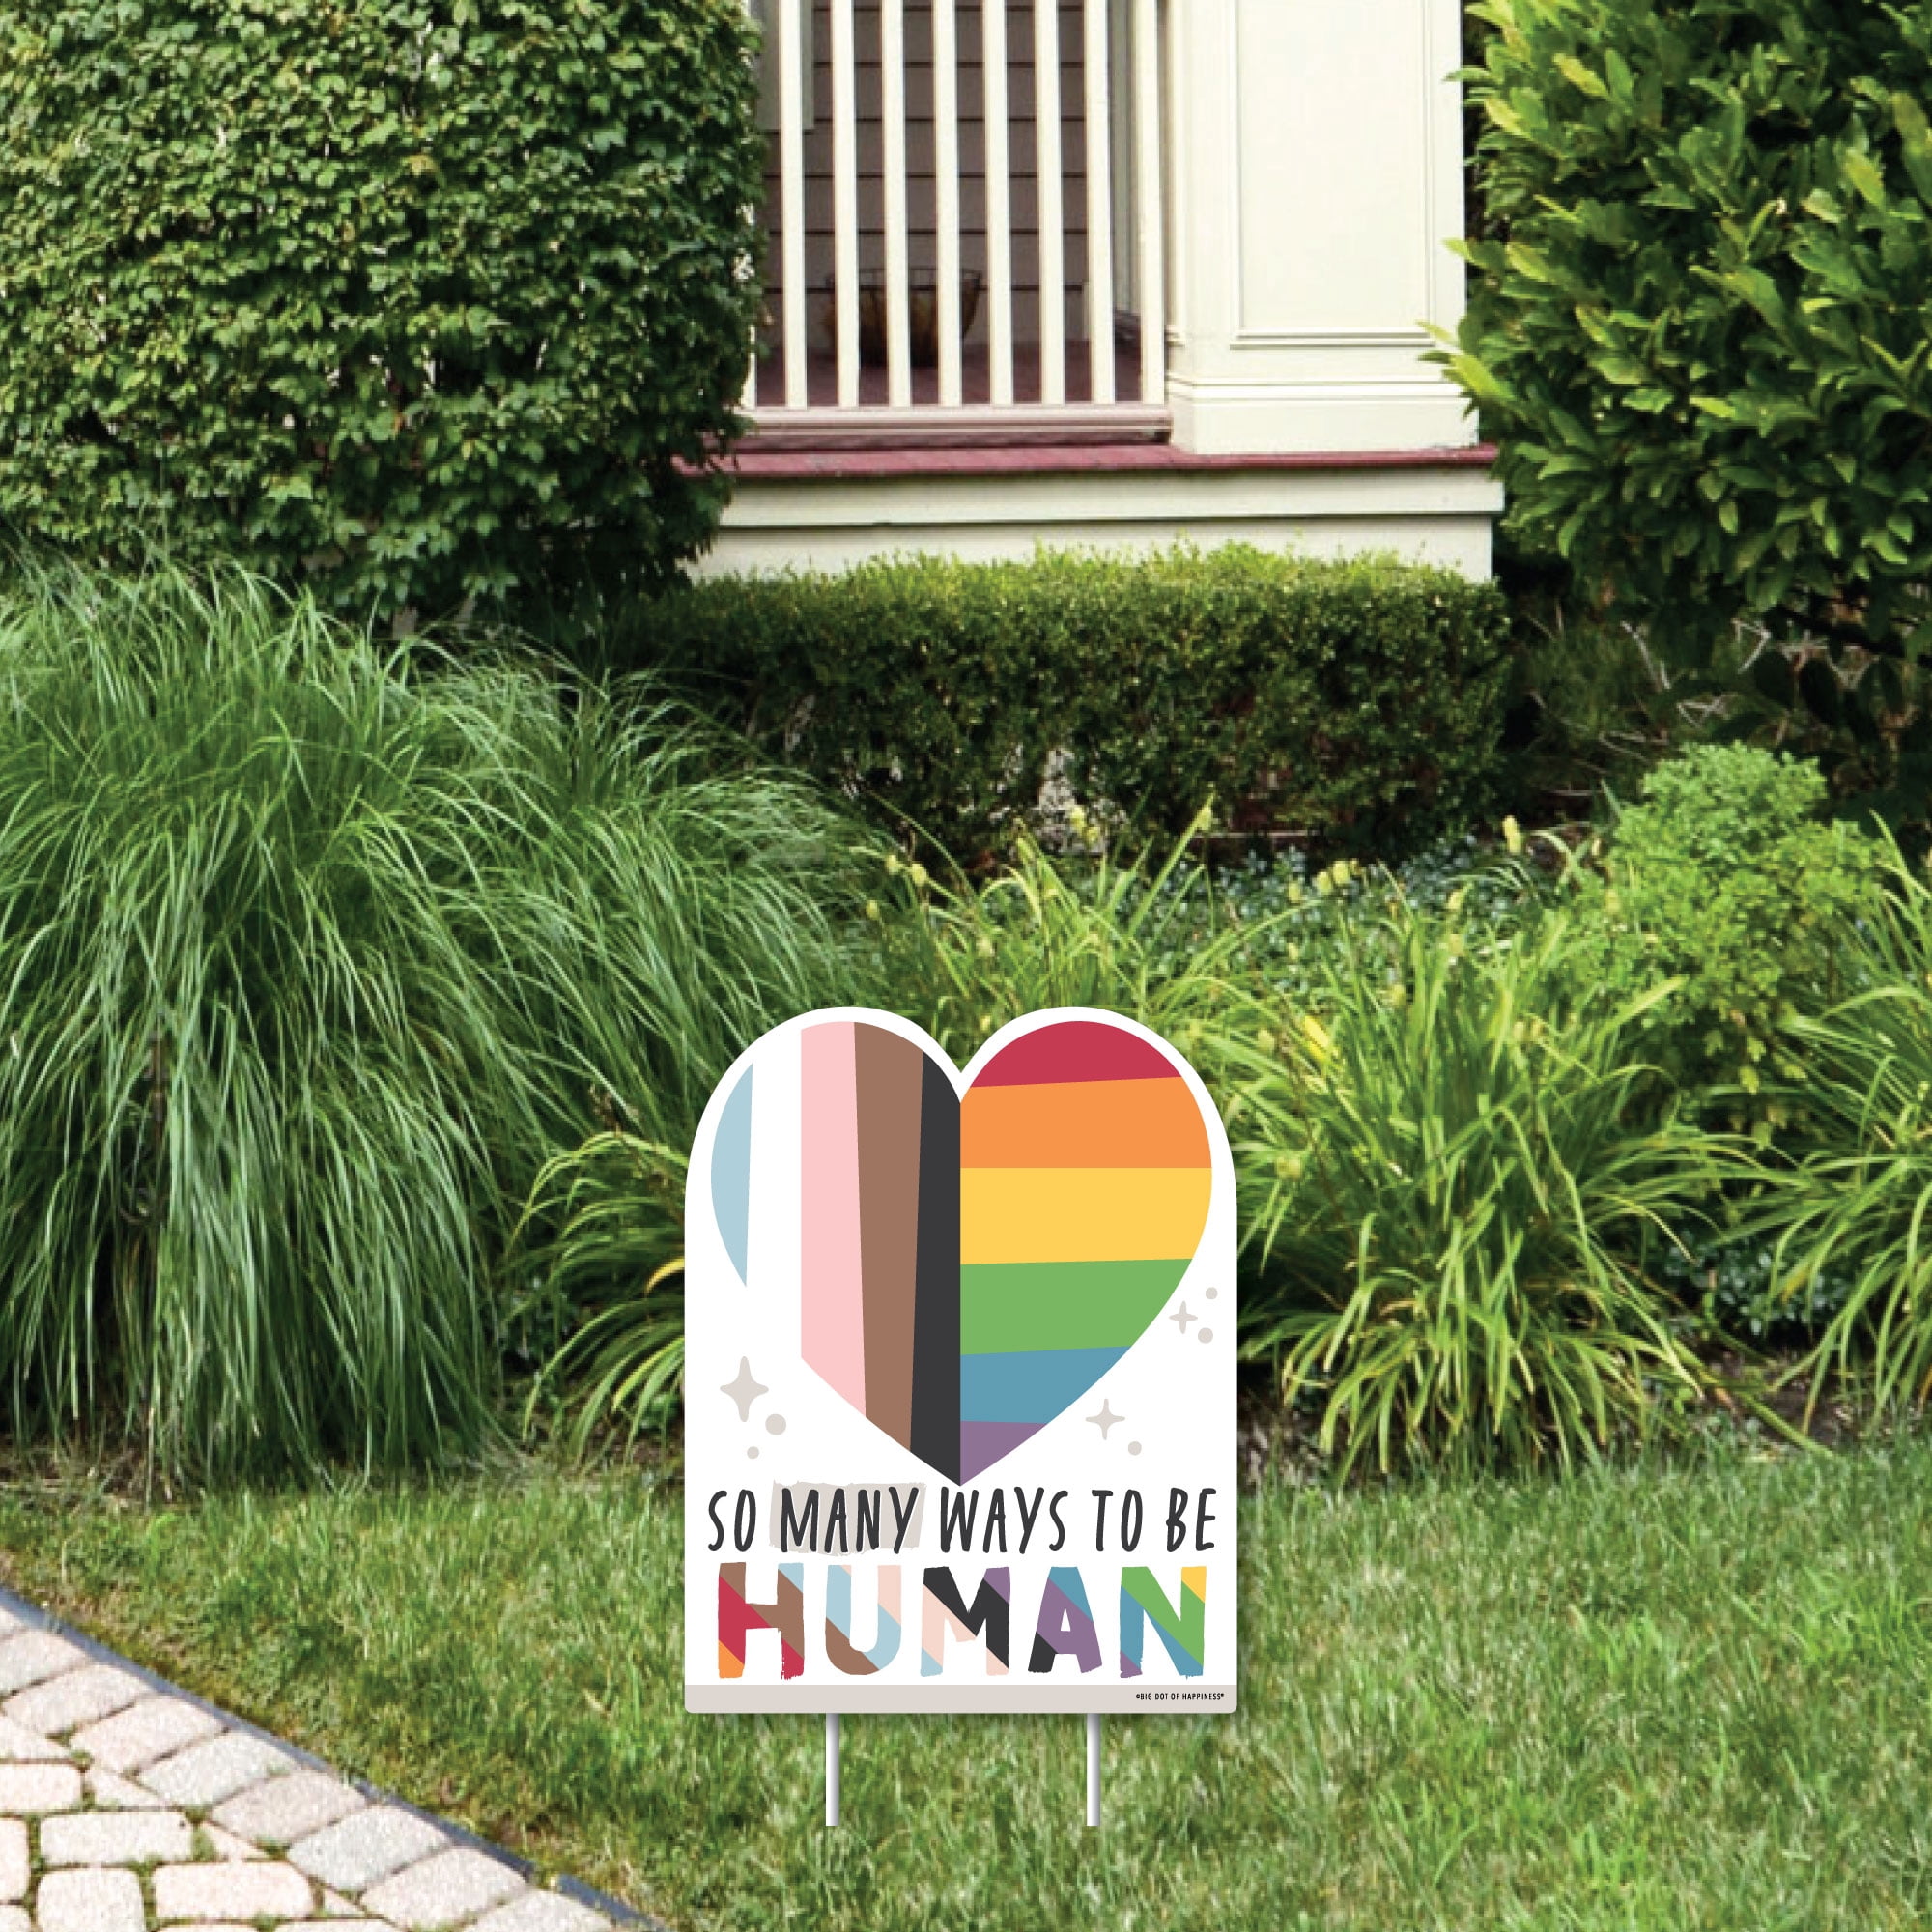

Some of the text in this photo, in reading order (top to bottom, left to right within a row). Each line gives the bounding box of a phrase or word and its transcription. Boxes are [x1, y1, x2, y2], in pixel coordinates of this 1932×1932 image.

[707, 1486, 1217, 1554] SO MANY WAYS TO BE
[717, 1561, 1208, 1682] HUMAN
[1154, 1692, 1169, 1701] DOT
[1170, 1692, 1180, 1701] OF
